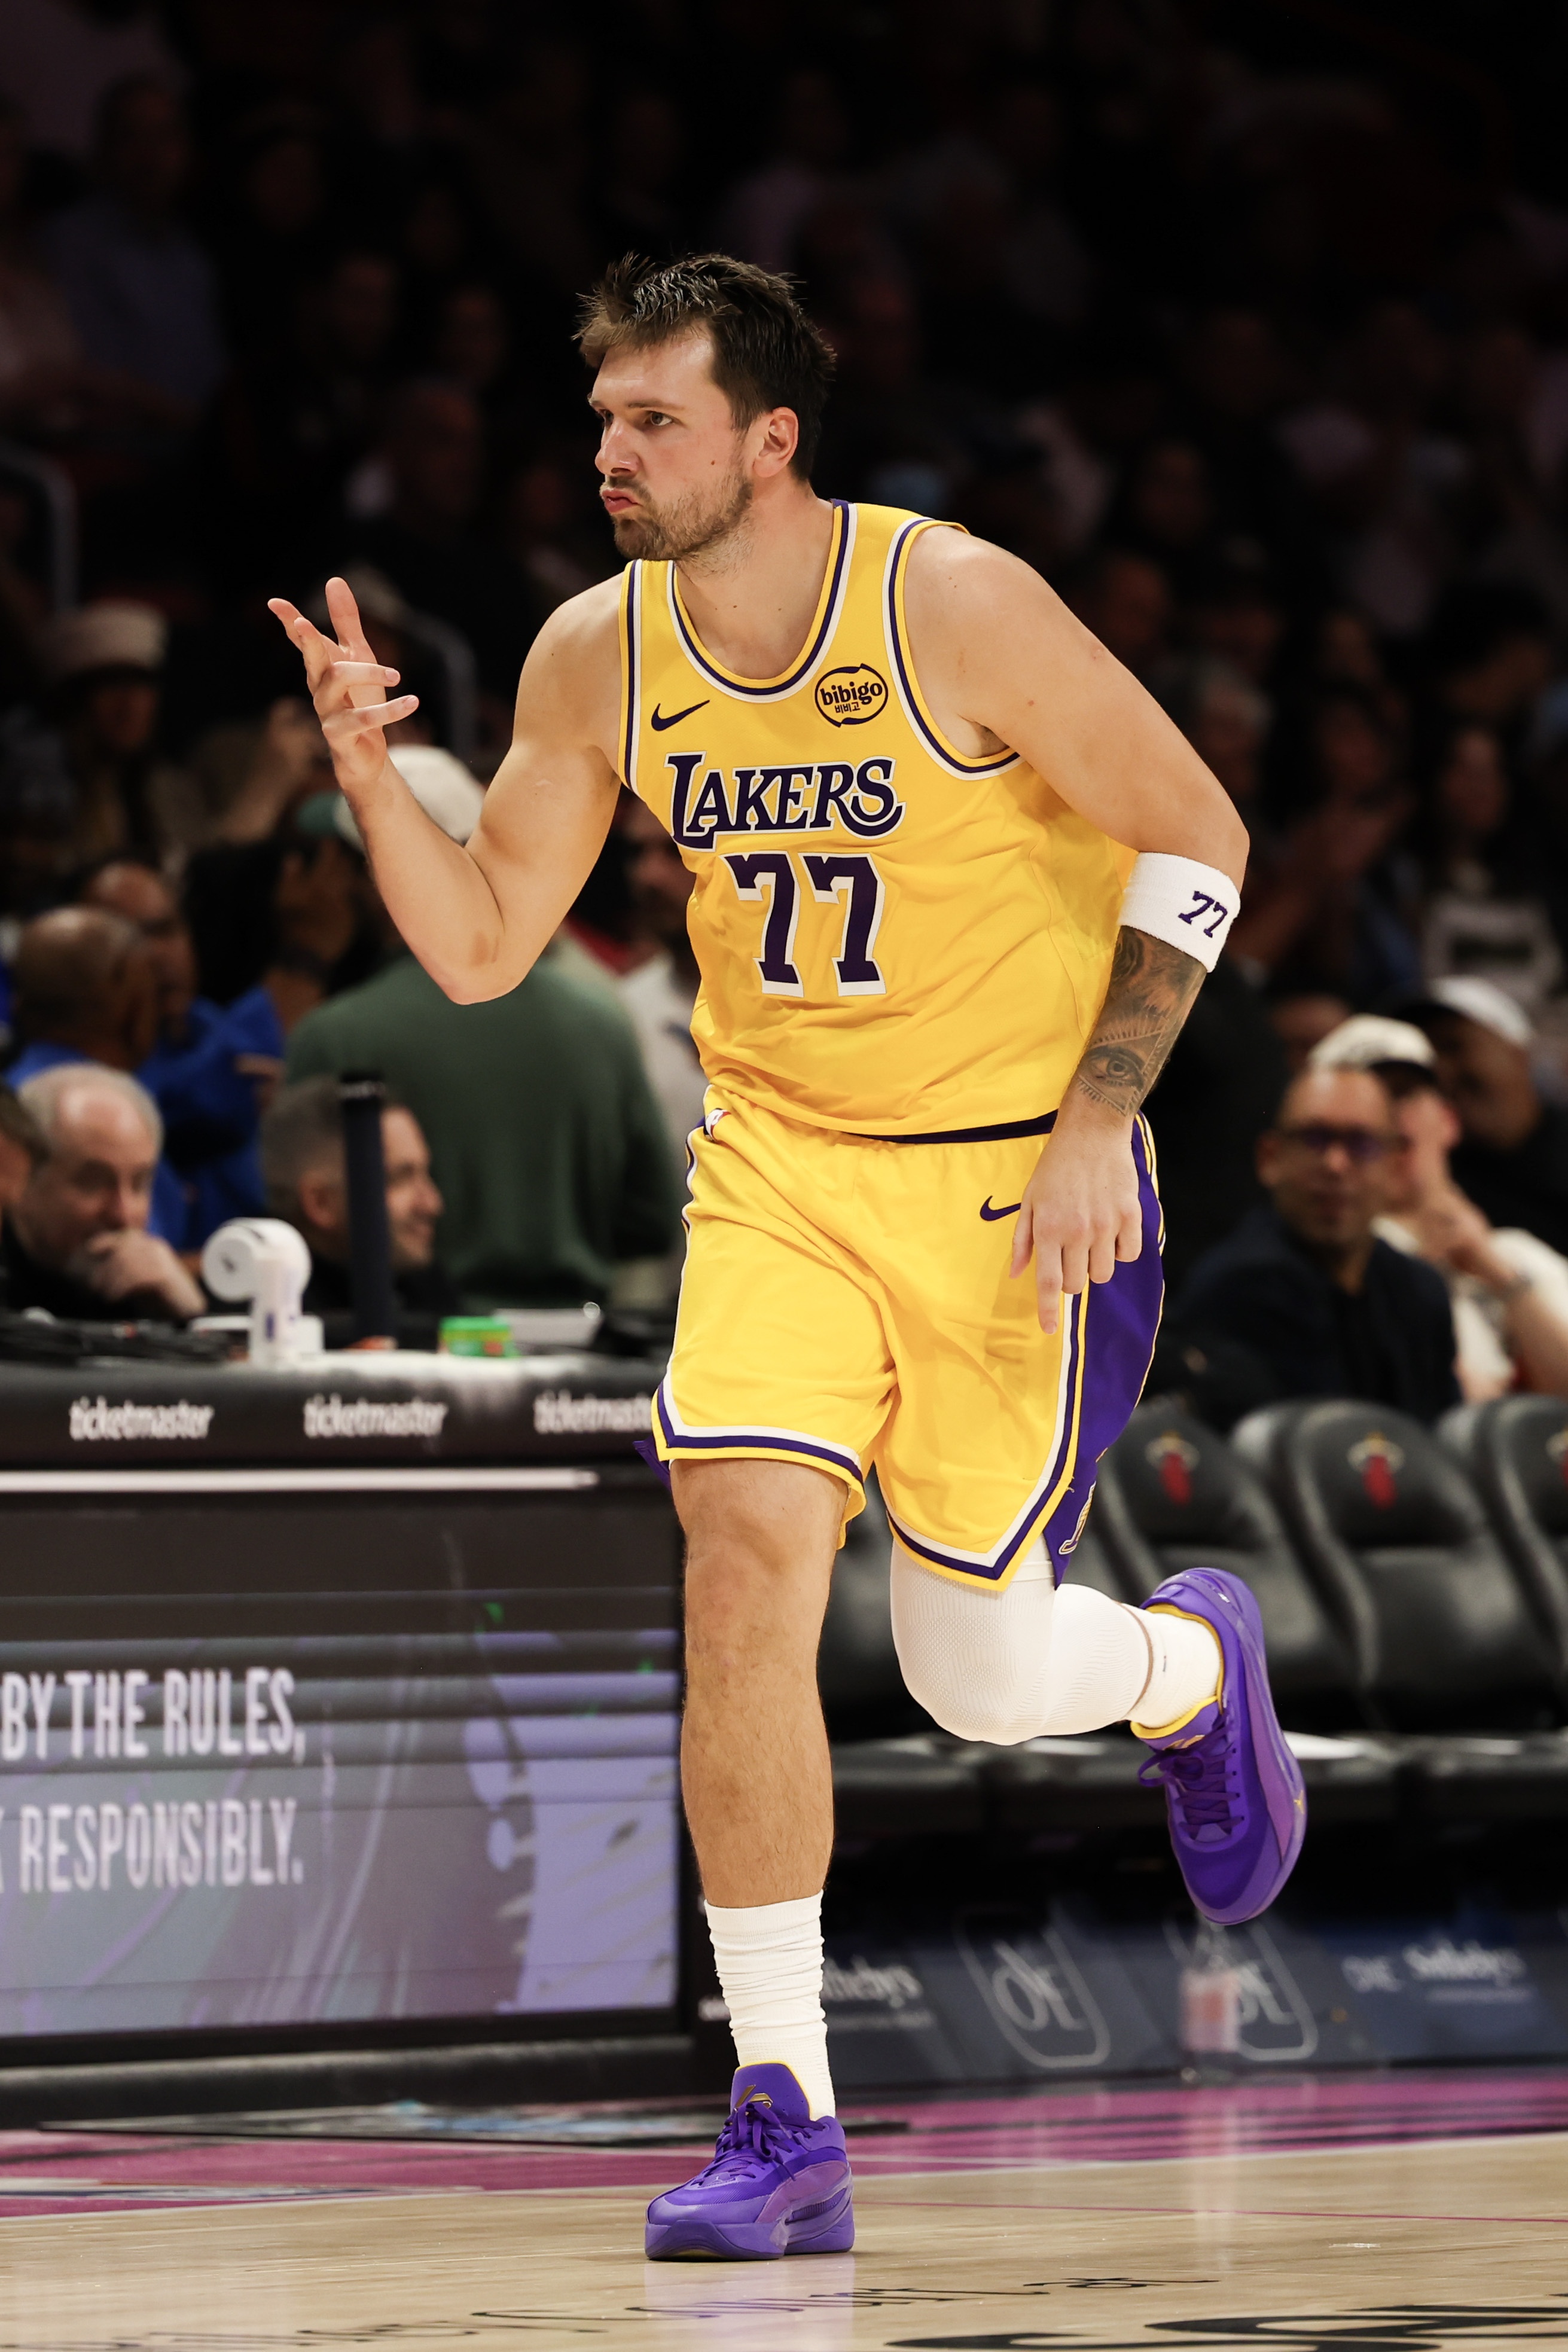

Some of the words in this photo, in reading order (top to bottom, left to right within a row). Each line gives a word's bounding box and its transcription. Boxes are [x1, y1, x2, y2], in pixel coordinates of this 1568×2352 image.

[820, 681, 883, 705] bibigo
[834, 701, 861, 713] 비비고
[664, 751, 906, 852] LAKERS
[719, 850, 886, 997] 77
[1178, 890, 1228, 938] 77
[69, 1395, 214, 1442] ticketmaster
[303, 1392, 447, 1439] ticketmaster
[1, 1671, 56, 1761] BY
[63, 1670, 150, 1759] THE
[163, 1666, 306, 1767] RULES,
[19, 1796, 304, 1893] RESPONSIBLY.
